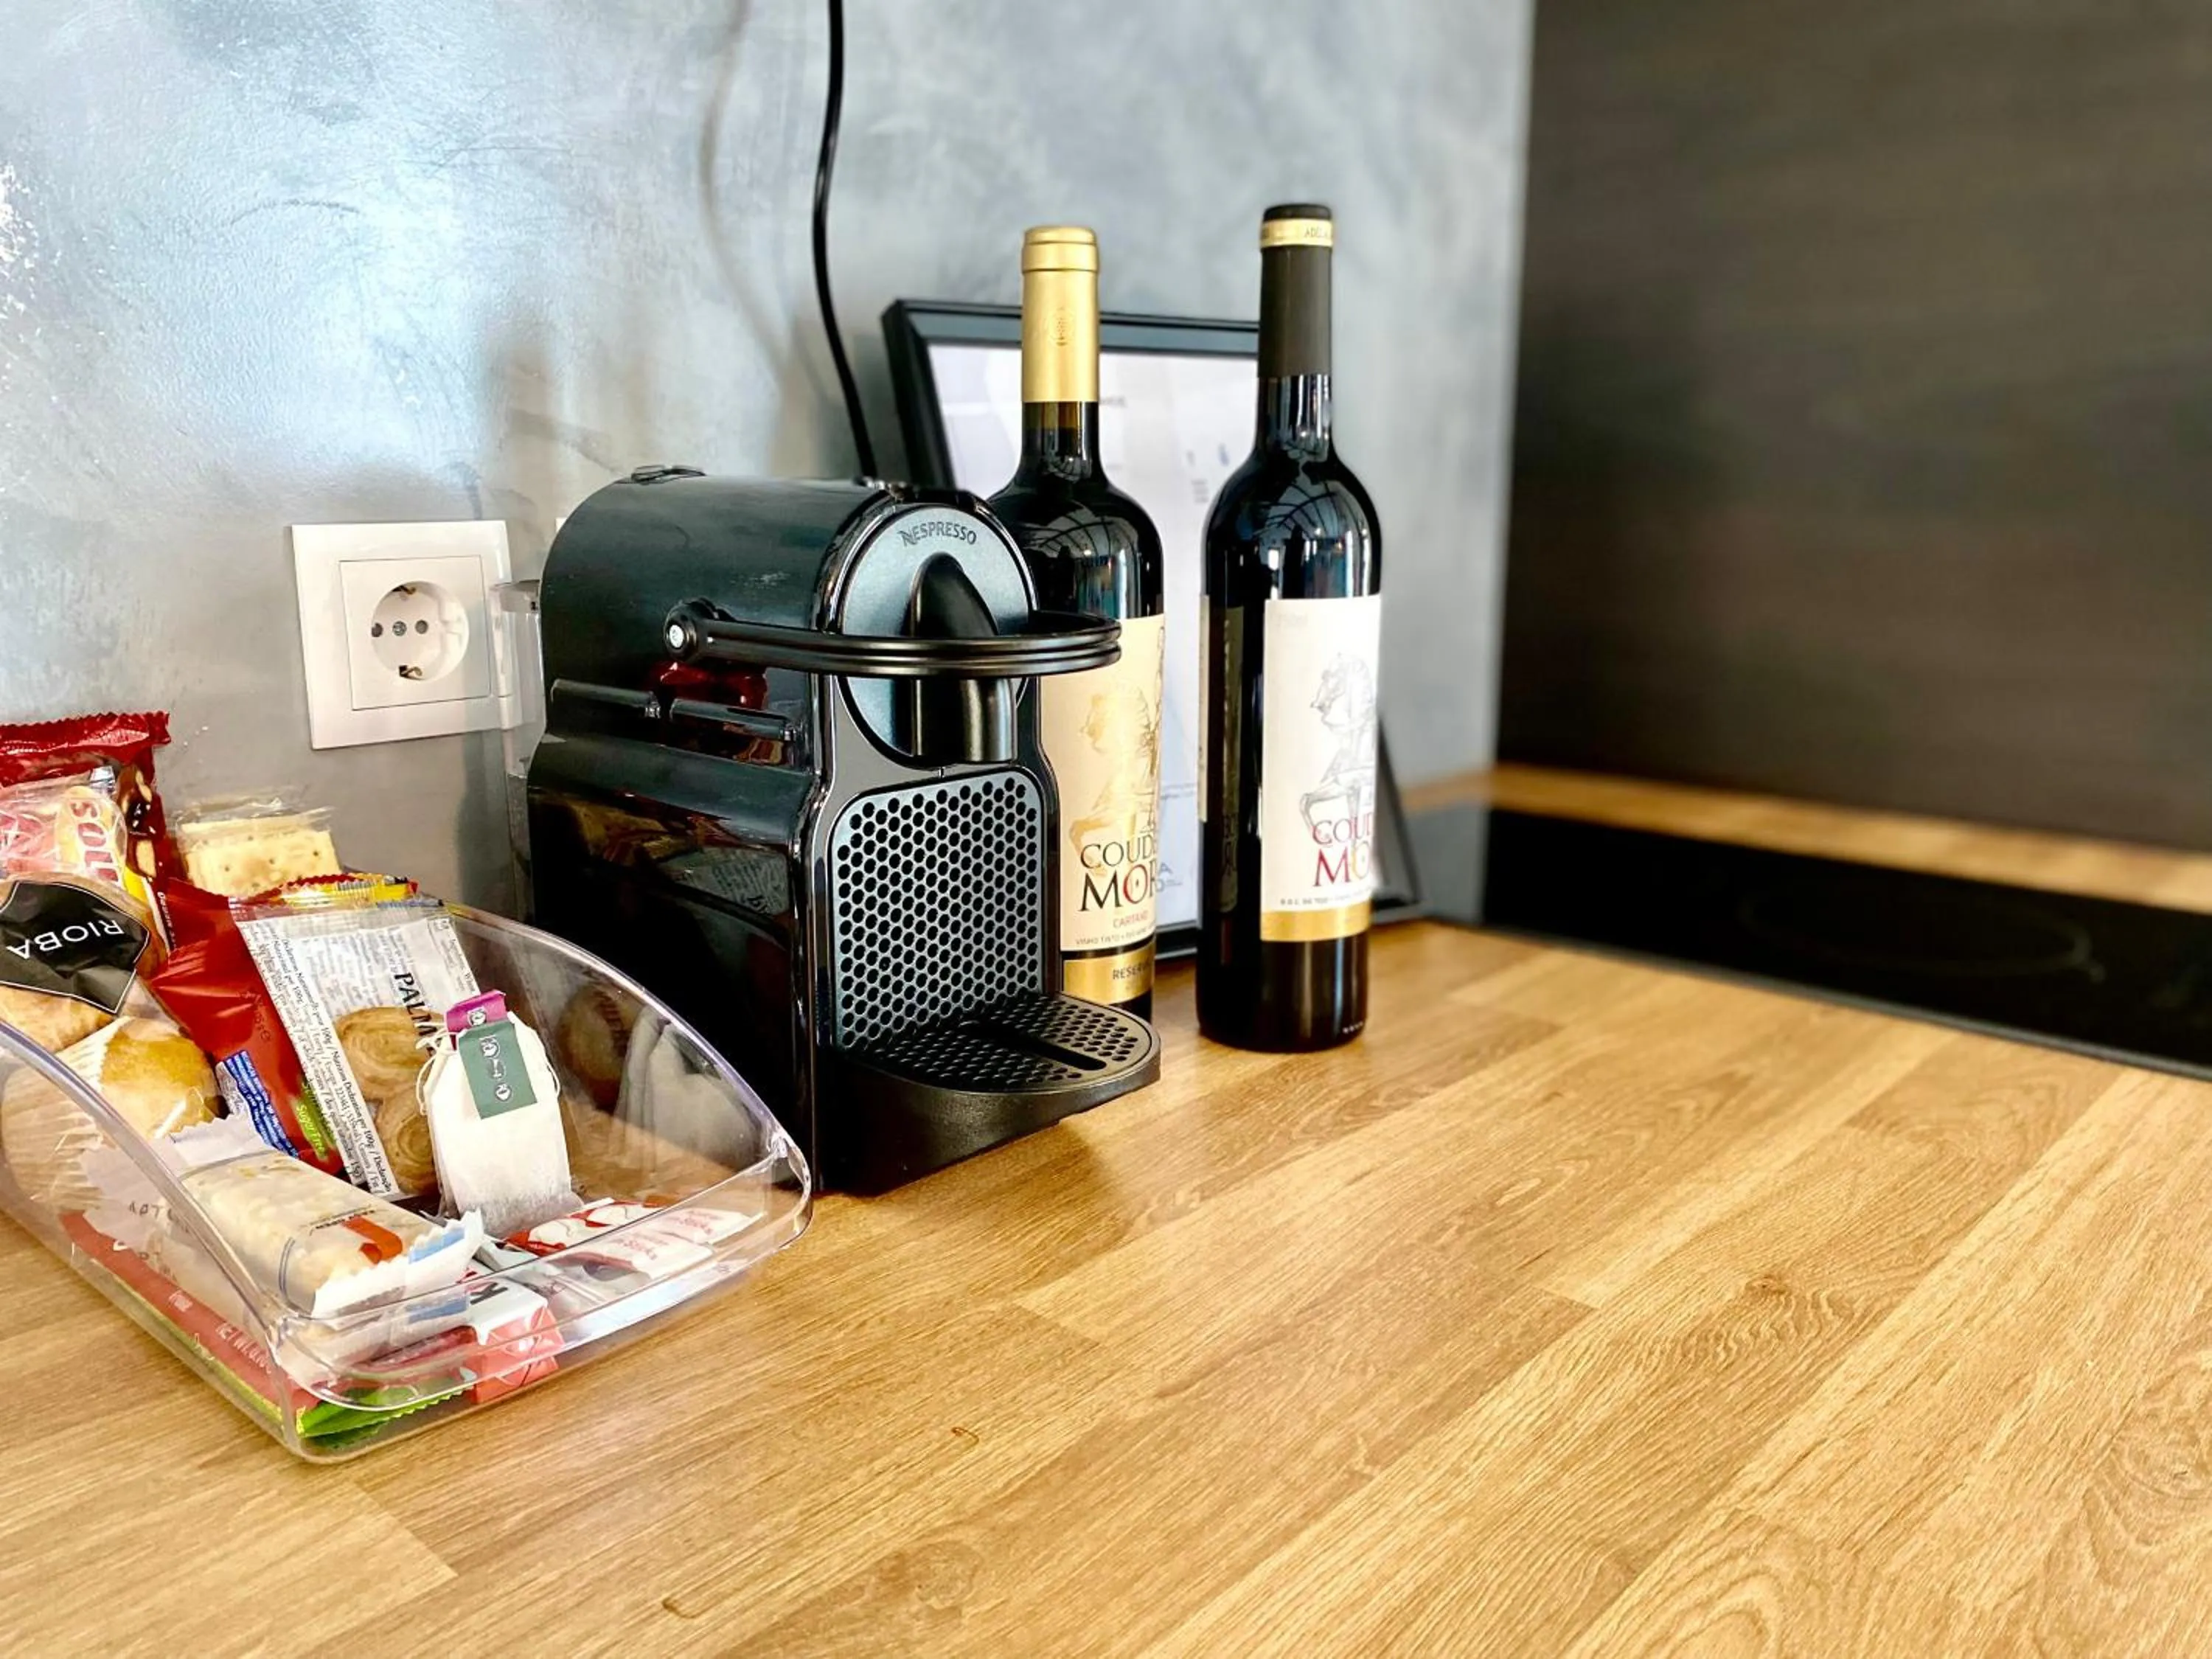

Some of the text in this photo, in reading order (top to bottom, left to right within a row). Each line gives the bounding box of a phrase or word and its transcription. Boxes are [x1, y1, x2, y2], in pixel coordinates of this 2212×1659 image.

[898, 521, 977, 547] NESPRESSO
[1080, 835, 1155, 869] COUD
[5, 920, 125, 960] RIOBA
[394, 973, 439, 1046] PALM
